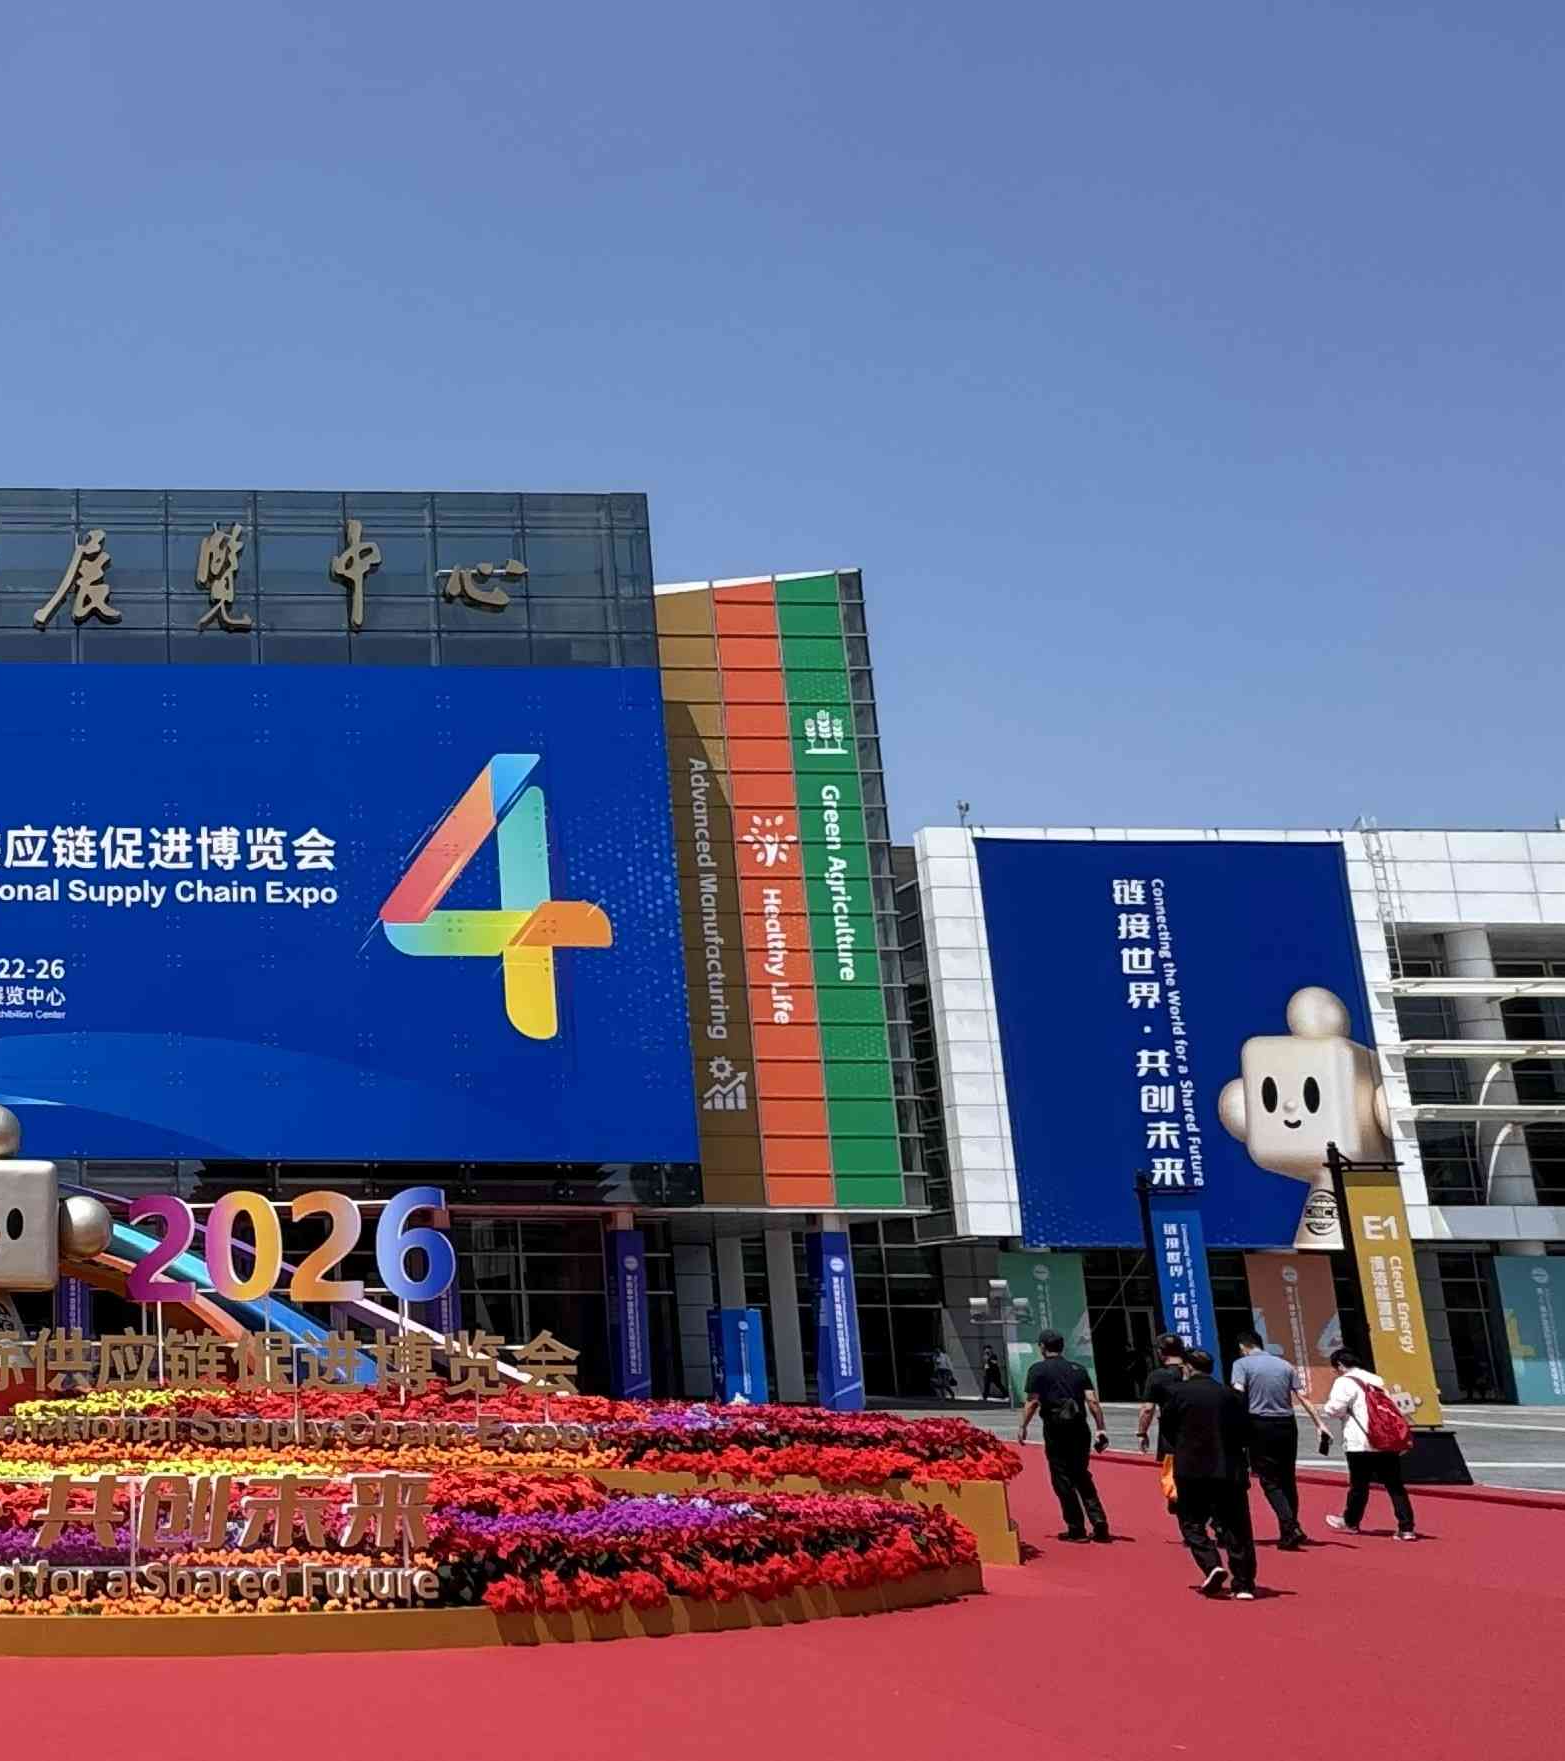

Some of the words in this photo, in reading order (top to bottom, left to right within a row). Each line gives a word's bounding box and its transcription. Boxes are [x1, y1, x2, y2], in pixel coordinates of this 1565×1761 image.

[689, 757, 717, 868] Advanced
[821, 785, 841, 850] Green
[68, 880, 166, 908] Supply
[175, 881, 257, 904] Chain
[265, 882, 338, 908] Expo
[379, 753, 613, 1040] 4
[824, 855, 856, 982] Agriculture
[1151, 878, 1173, 959] Connecting
[698, 871, 728, 1041] Manufacturing
[762, 888, 788, 977] Healthy
[1163, 962, 1177, 986] the
[770, 982, 794, 1025] Life
[1167, 990, 1187, 1035] World
[1174, 1039, 1189, 1061] for
[1180, 1079, 1201, 1132] Shared
[1187, 1136, 1205, 1187] Future
[126, 1187, 457, 1303] 2026
[1362, 1215, 1400, 1240] E1
[1389, 1255, 1406, 1299] Clean
[1396, 1302, 1416, 1354] Energy
[191, 1408, 326, 1450] Supply
[477, 1414, 588, 1452] Expo
[36, 1559, 94, 1598] for
[106, 1568, 129, 1598] a
[142, 1559, 290, 1600] Shared
[303, 1562, 441, 1601] Future
